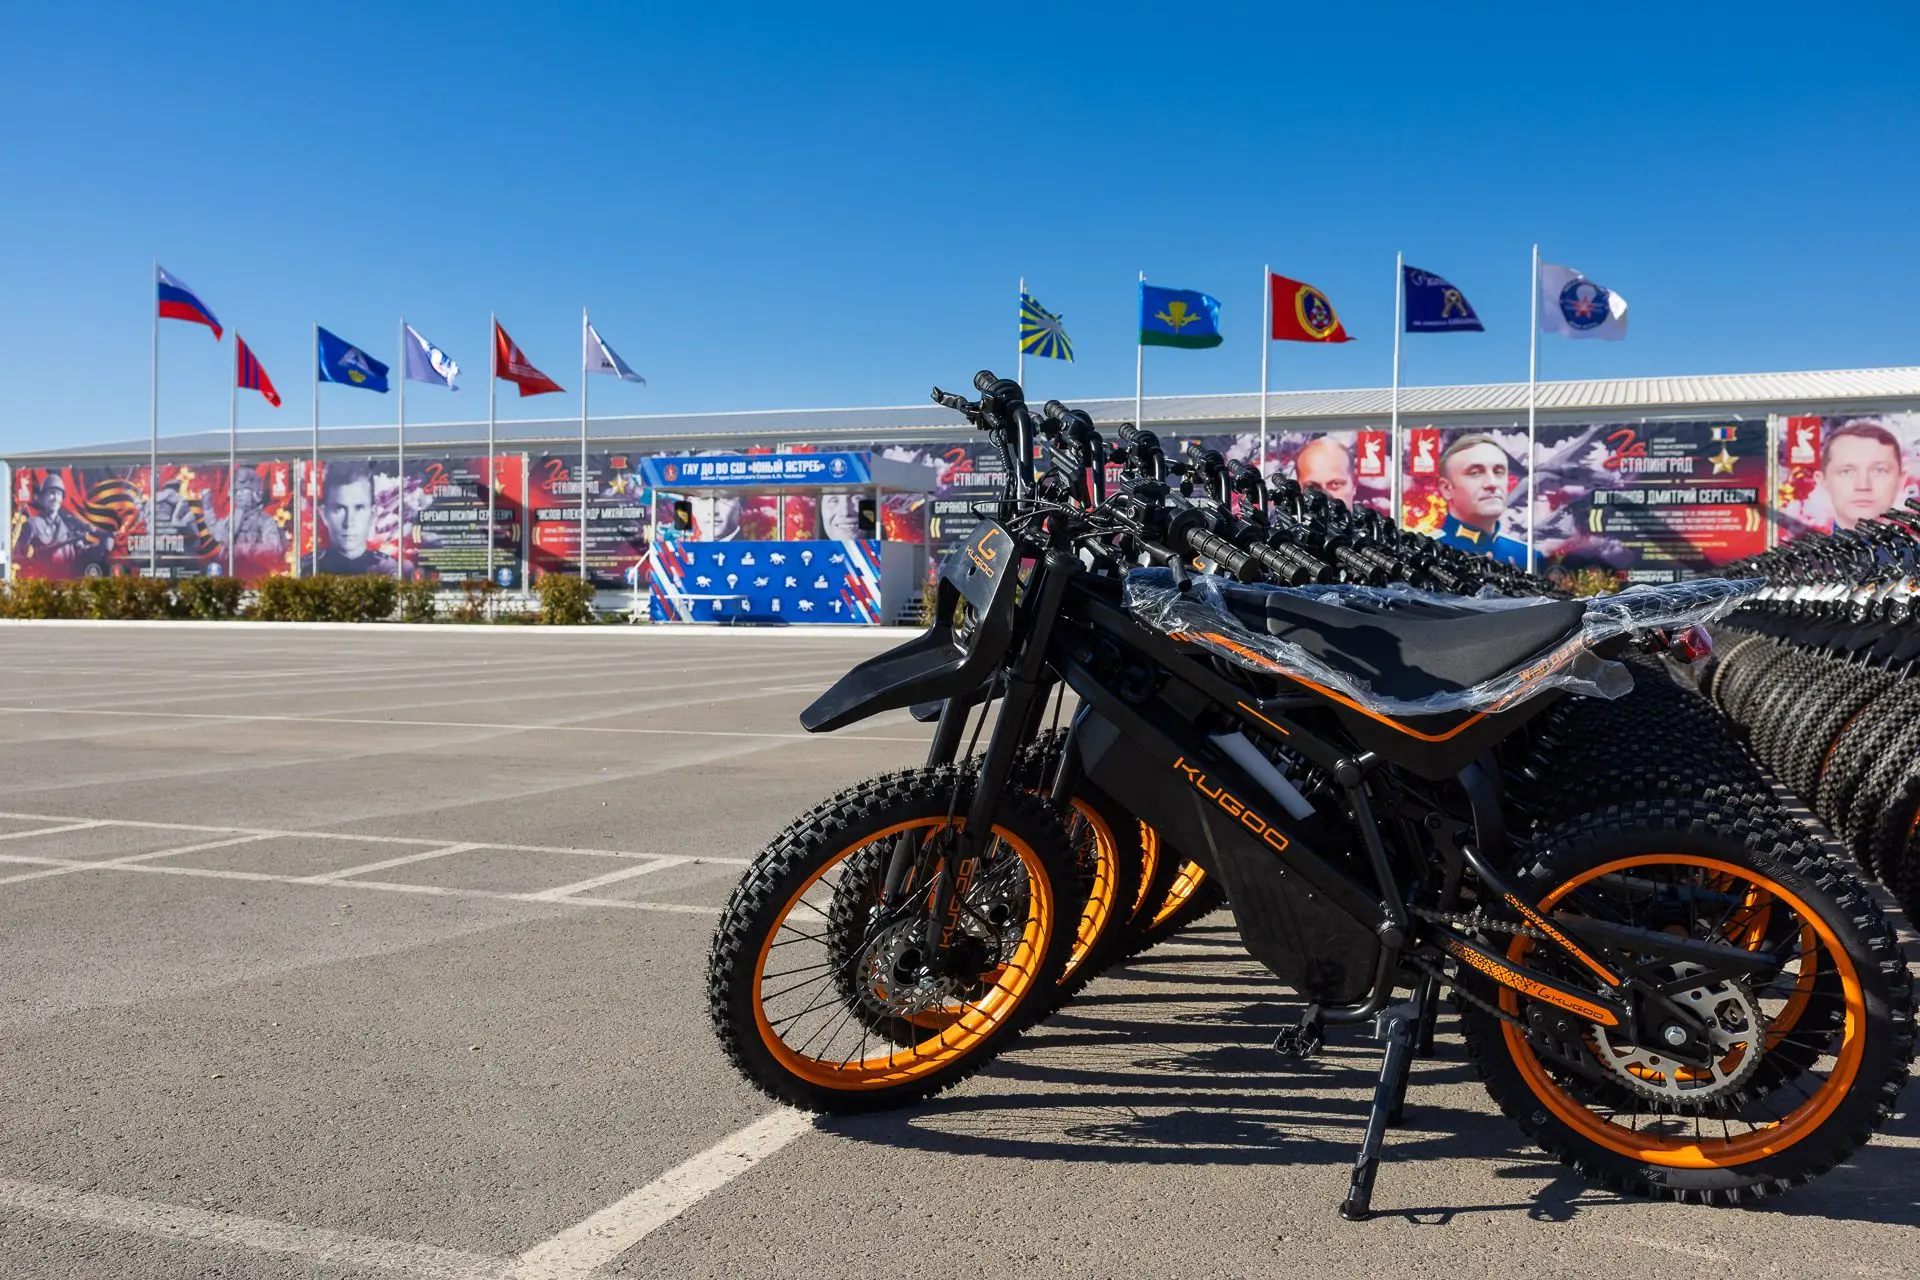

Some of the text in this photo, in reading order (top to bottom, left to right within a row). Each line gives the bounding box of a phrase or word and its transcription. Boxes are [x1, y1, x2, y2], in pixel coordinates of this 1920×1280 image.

[682, 463, 699, 475] ГАУ
[701, 463, 714, 476] ДО
[730, 461, 746, 474] СШ
[748, 459, 783, 474] «ЮНЫЙ
[785, 459, 825, 473] ЯСТРЕБ»
[1620, 457, 1693, 474] СТАЛИНГРАД
[1647, 487, 1697, 504] ДМИТРИЙ
[1699, 488, 1757, 504] СЕРГЕЕВИЧ
[965, 542, 995, 578] KUGOO
[1173, 756, 1289, 851] KUGOO
[1551, 996, 1604, 1020] KUGOO
